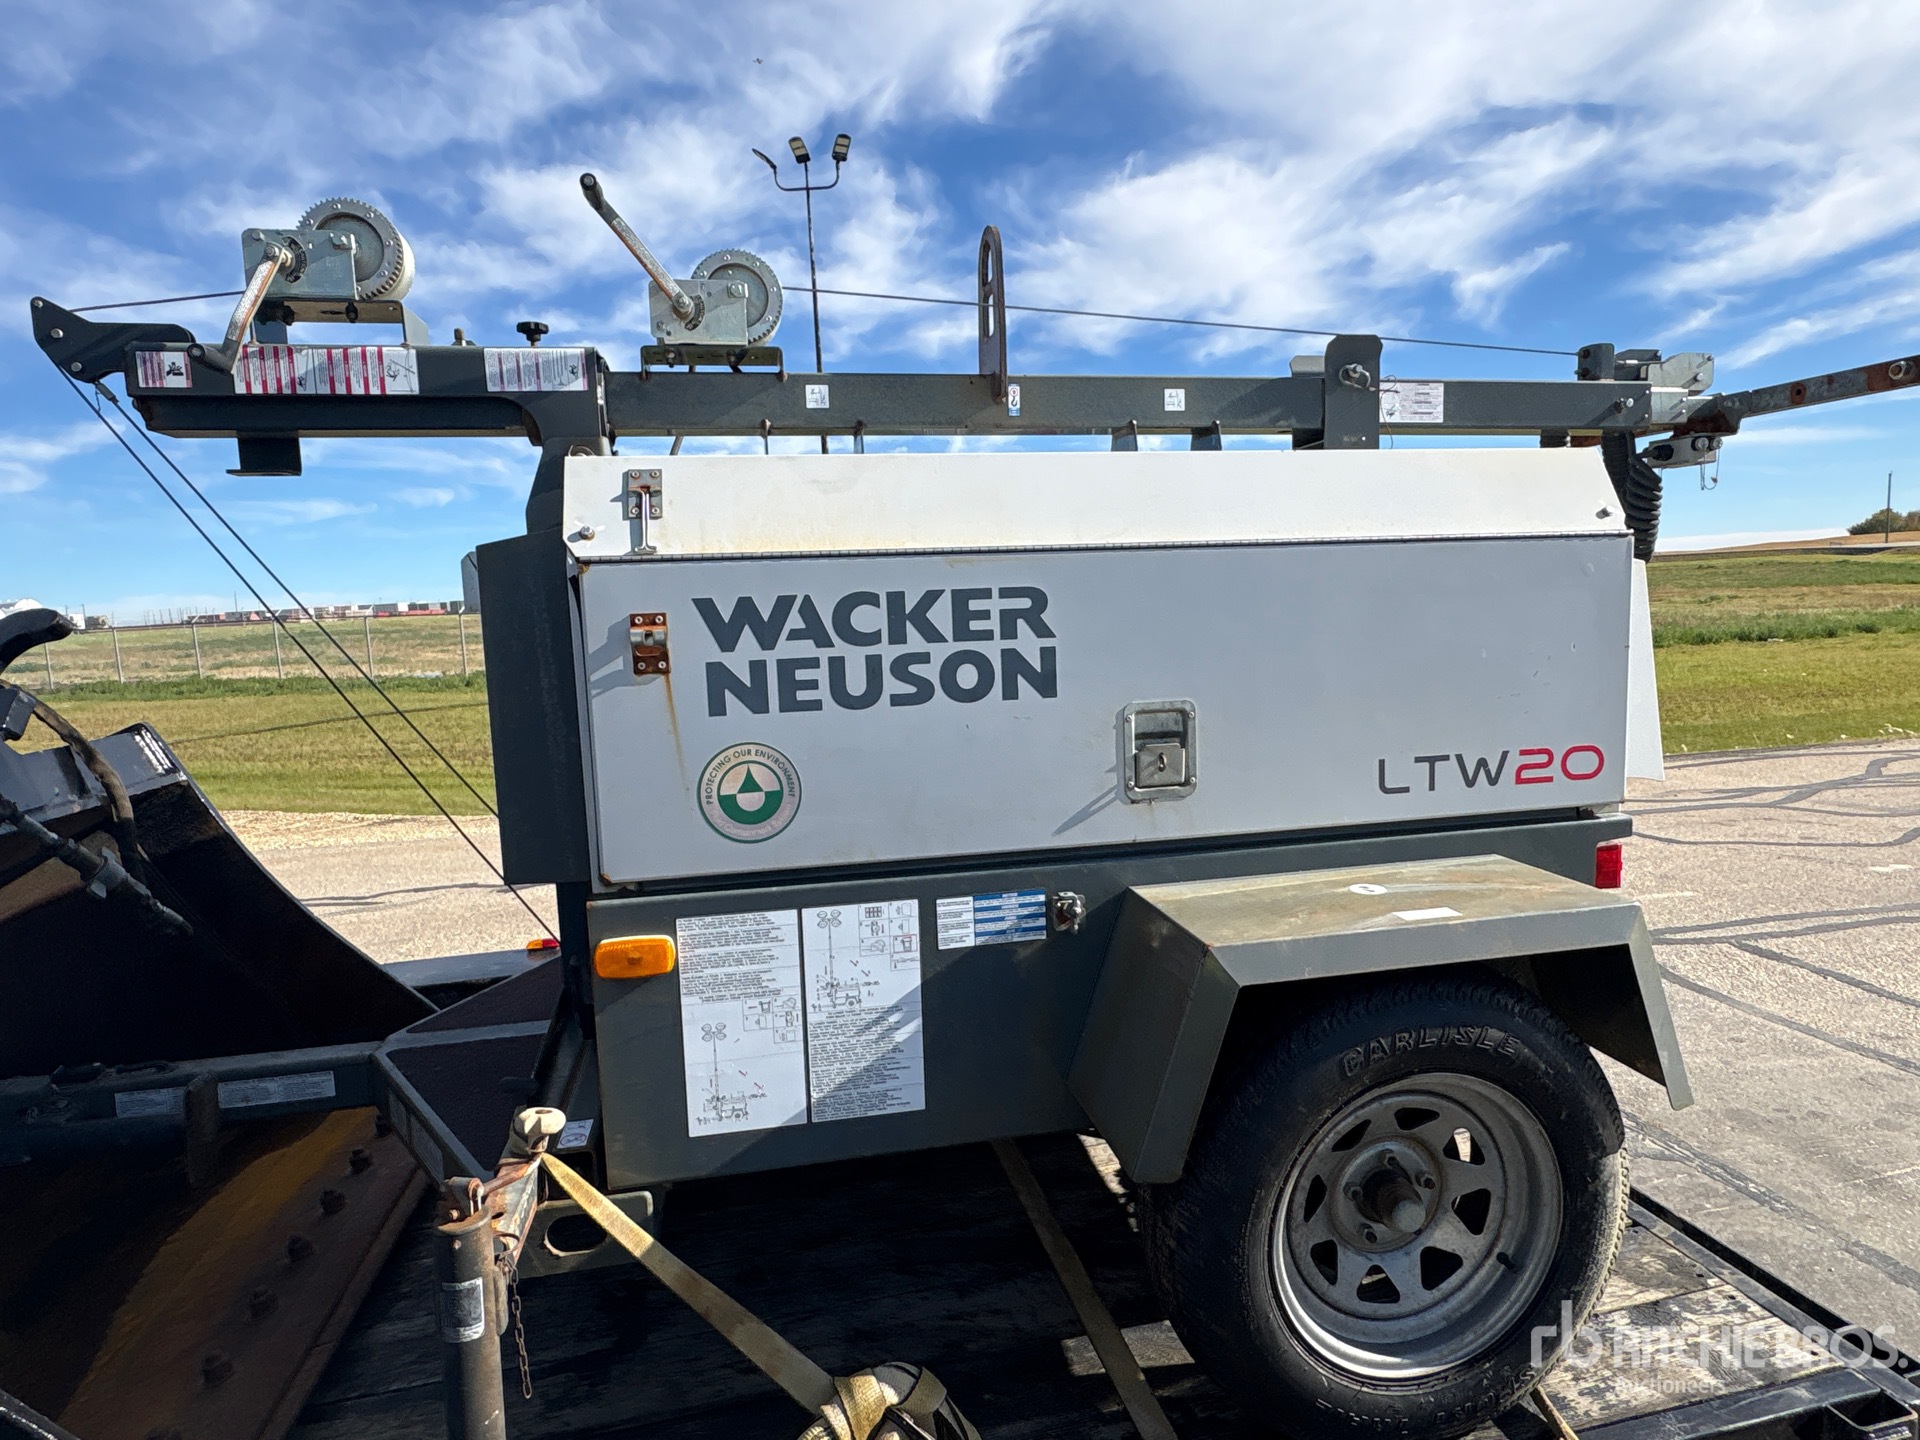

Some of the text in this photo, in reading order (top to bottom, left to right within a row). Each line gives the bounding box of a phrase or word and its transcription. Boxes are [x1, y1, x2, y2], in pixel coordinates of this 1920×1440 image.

[691, 586, 1057, 653] WACKER
[705, 646, 1058, 717] NEUSON
[705, 748, 795, 805] PROTECTING OUR ENVIRONMENT
[1378, 744, 1605, 795] LTW20
[1342, 1025, 1521, 1077] CARLISLE
